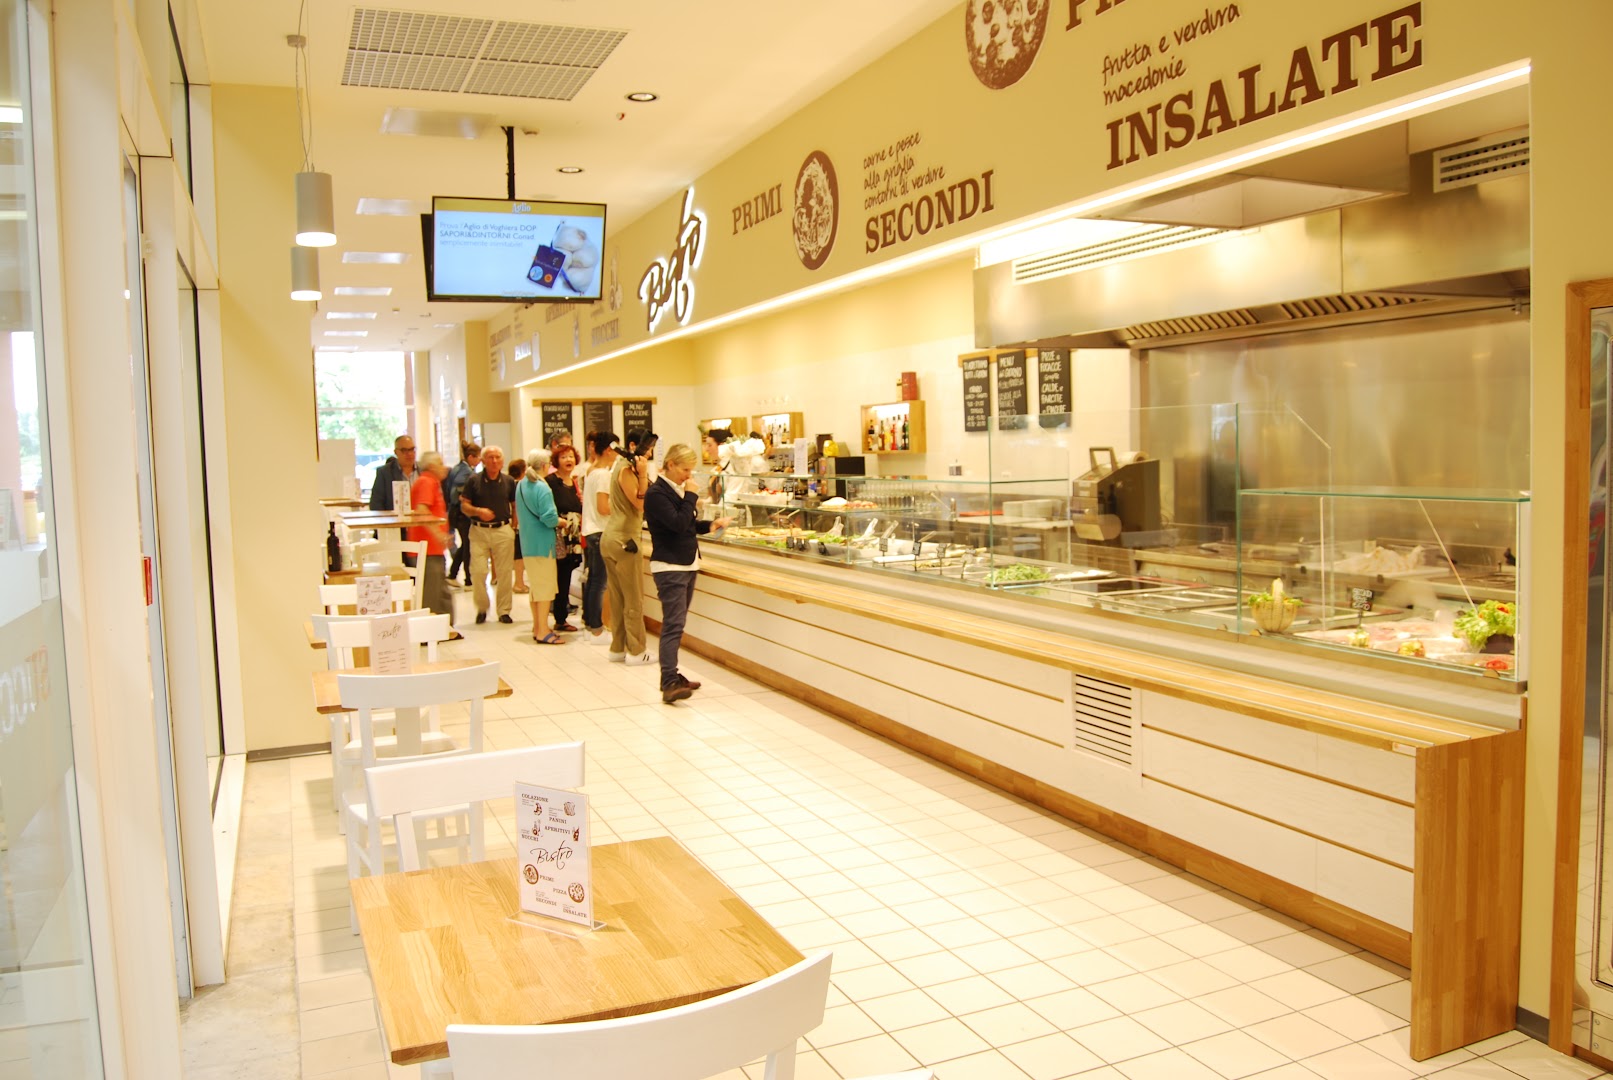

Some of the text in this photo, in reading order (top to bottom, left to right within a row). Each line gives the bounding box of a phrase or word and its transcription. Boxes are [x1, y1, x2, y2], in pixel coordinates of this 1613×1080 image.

[1102, 43, 1152, 86] frutta
[1158, 36, 1171, 53] e
[1174, 3, 1241, 46] verdura
[1103, 56, 1187, 106] macedonie
[1106, 2, 1425, 171] INSALATE
[863, 132, 921, 170] carne e pesce
[864, 154, 915, 190] alla griglia
[864, 166, 945, 211] contorni di verdure
[512, 201, 532, 215] Aglio
[731, 183, 783, 236] PRIMI
[865, 169, 995, 254] SECONDI
[521, 793, 549, 803] COLAZIONE
[549, 816, 567, 825] PANINI
[544, 826, 571, 835] APERITIVI
[521, 834, 539, 842] SUCCHI
[539, 874, 555, 883] PRIMI
[552, 887, 567, 896] PIZZA
[535, 897, 557, 907] SECONDI
[562, 908, 588, 918] INSALATE
